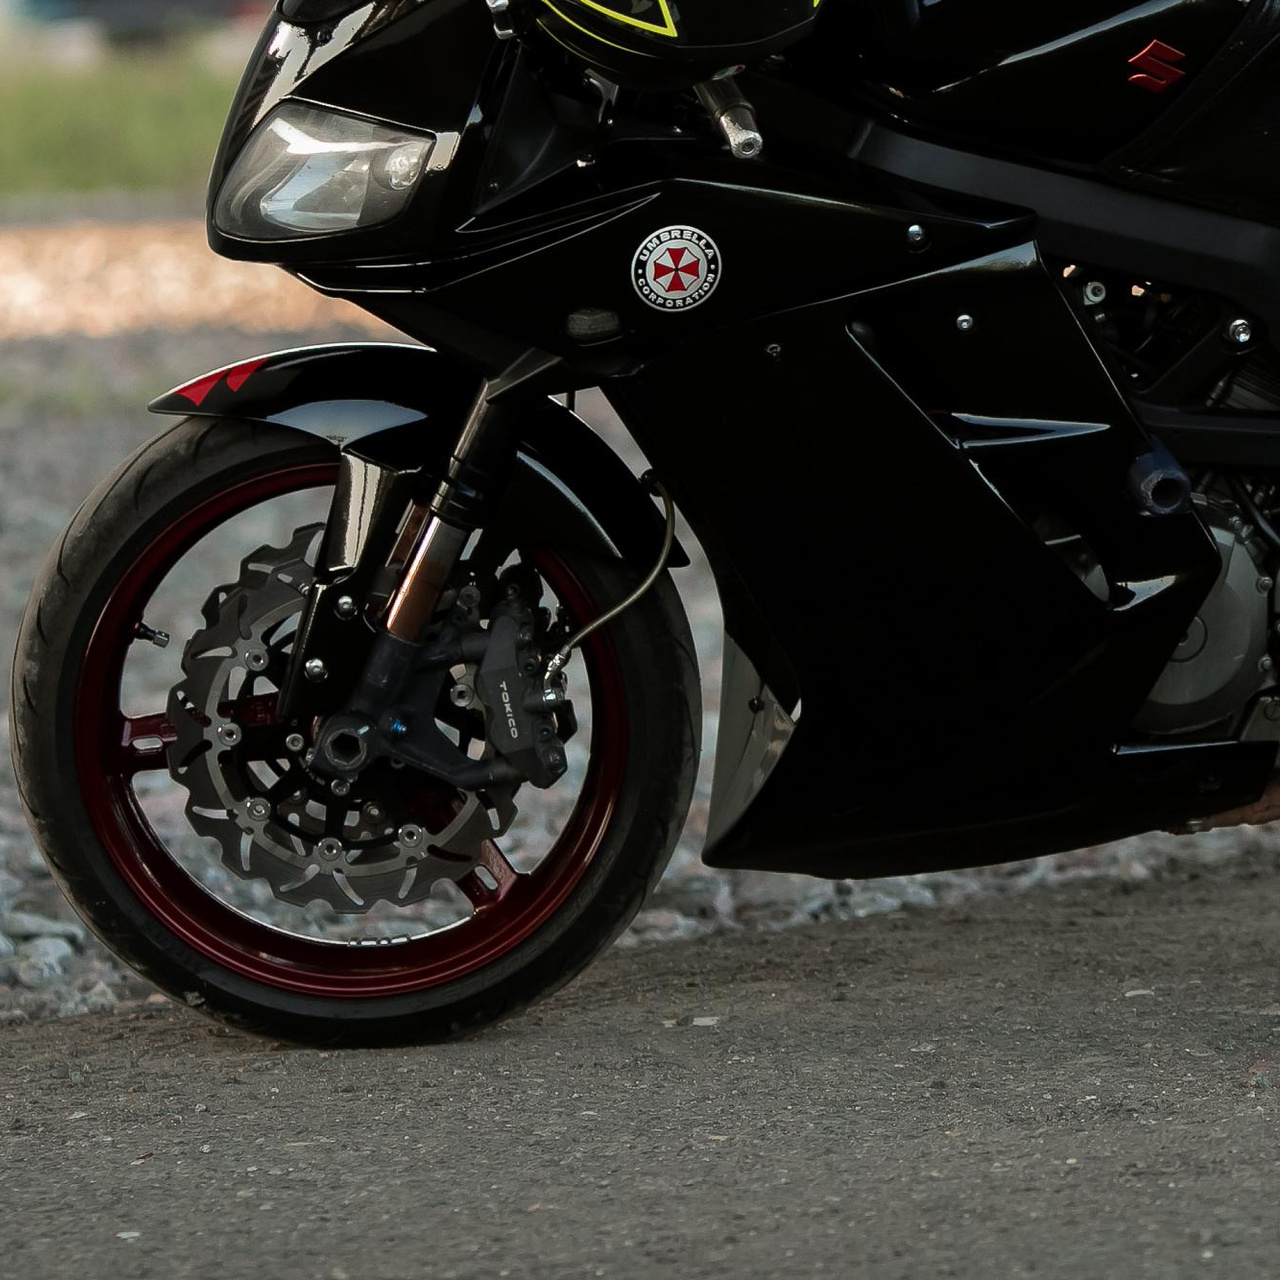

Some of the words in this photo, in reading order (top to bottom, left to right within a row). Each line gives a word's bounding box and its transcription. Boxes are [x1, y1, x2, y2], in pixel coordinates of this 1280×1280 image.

[639, 229, 715, 261] UMBRELLA
[638, 273, 716, 307] CORPORATION
[499, 680, 519, 739] TOKICO
